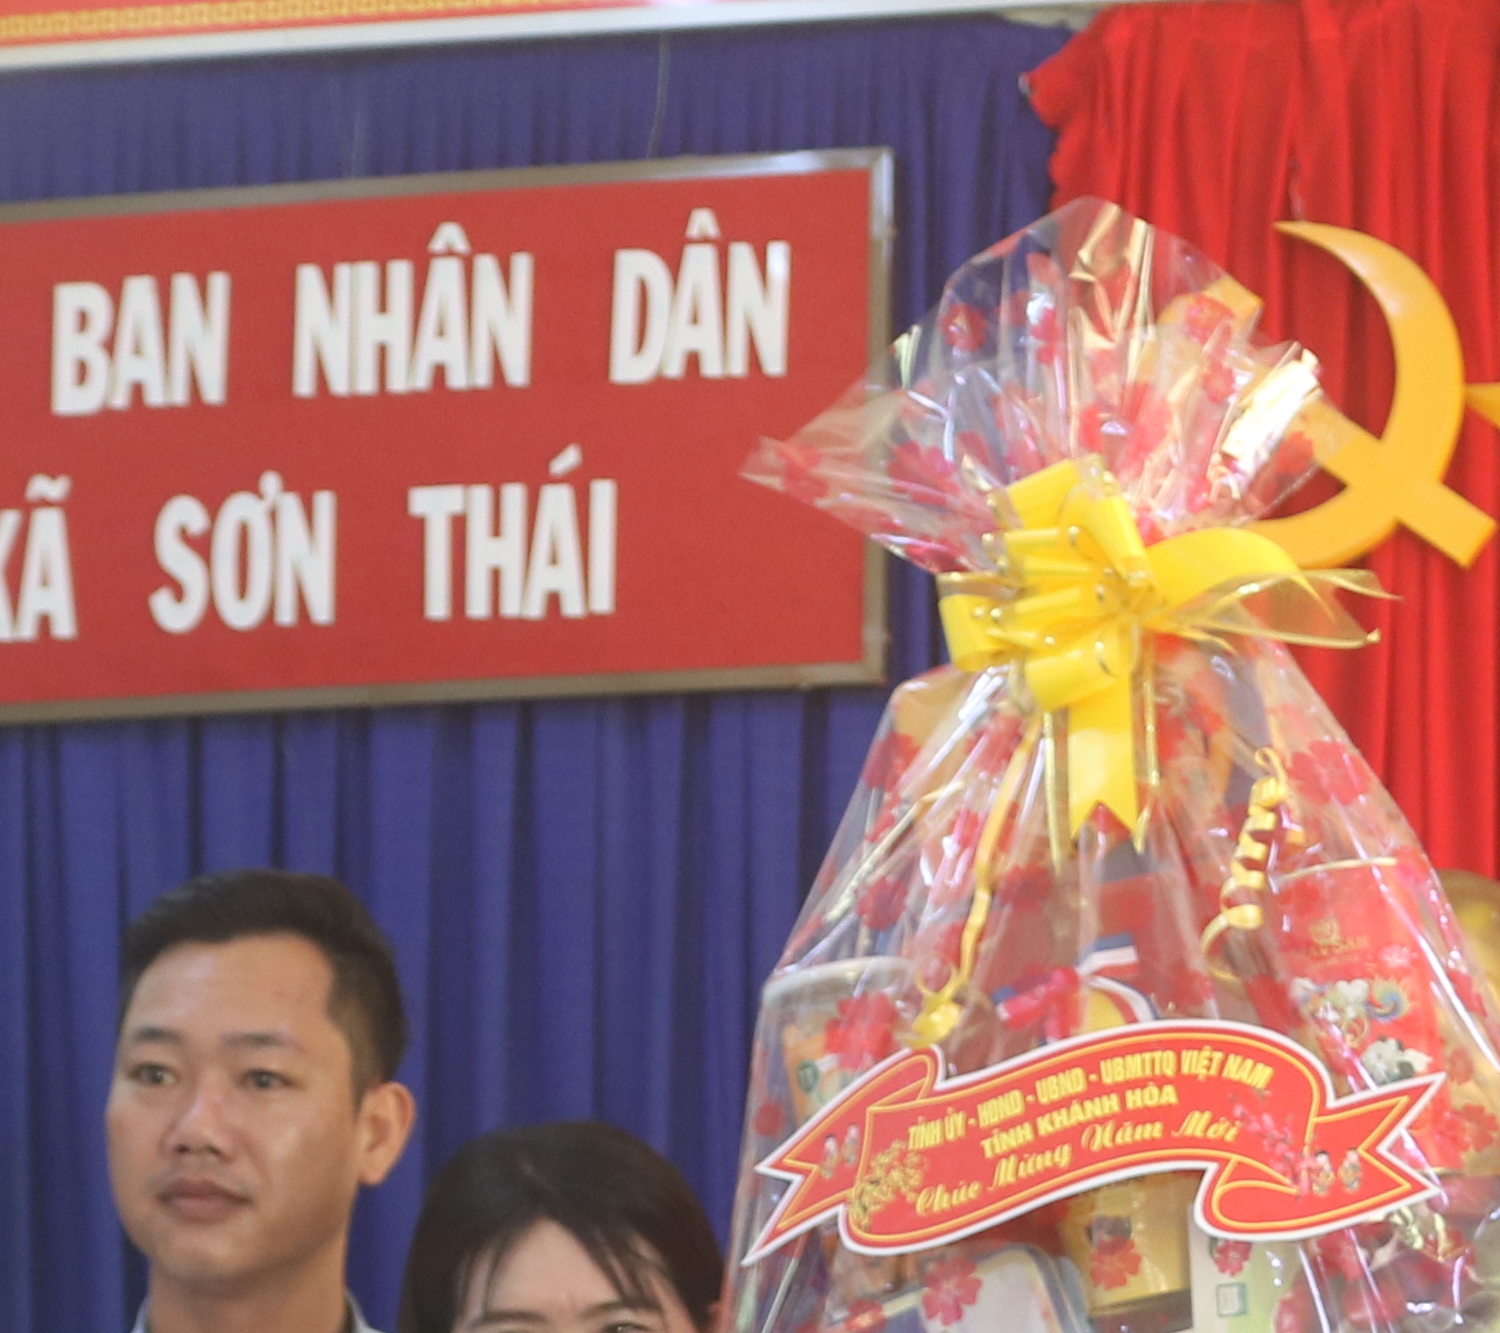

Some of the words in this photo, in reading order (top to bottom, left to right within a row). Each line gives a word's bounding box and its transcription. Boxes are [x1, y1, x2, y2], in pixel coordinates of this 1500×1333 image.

[51, 272, 230, 417] BAN
[292, 221, 534, 398] NHÂN
[610, 207, 790, 386] DÂN
[148, 471, 337, 634] SƠN
[407, 443, 618, 621] THÁI
[907, 1115, 944, 1150] TỈNH
[1034, 1066, 1088, 1104] UBND
[1100, 1050, 1177, 1085] UBMTTQ
[1181, 1045, 1224, 1081] VIỆT
[1222, 1053, 1274, 1089] NAM
[980, 1121, 1034, 1158] TỈNH
[1036, 1093, 1121, 1137] KHÁNH
[1125, 1082, 1179, 1110] HÒA
[915, 1180, 982, 1216] Chúc
[988, 1143, 1072, 1191] Mừng
[1081, 1120, 1164, 1151] Năm
[1171, 1110, 1244, 1142] Mới
